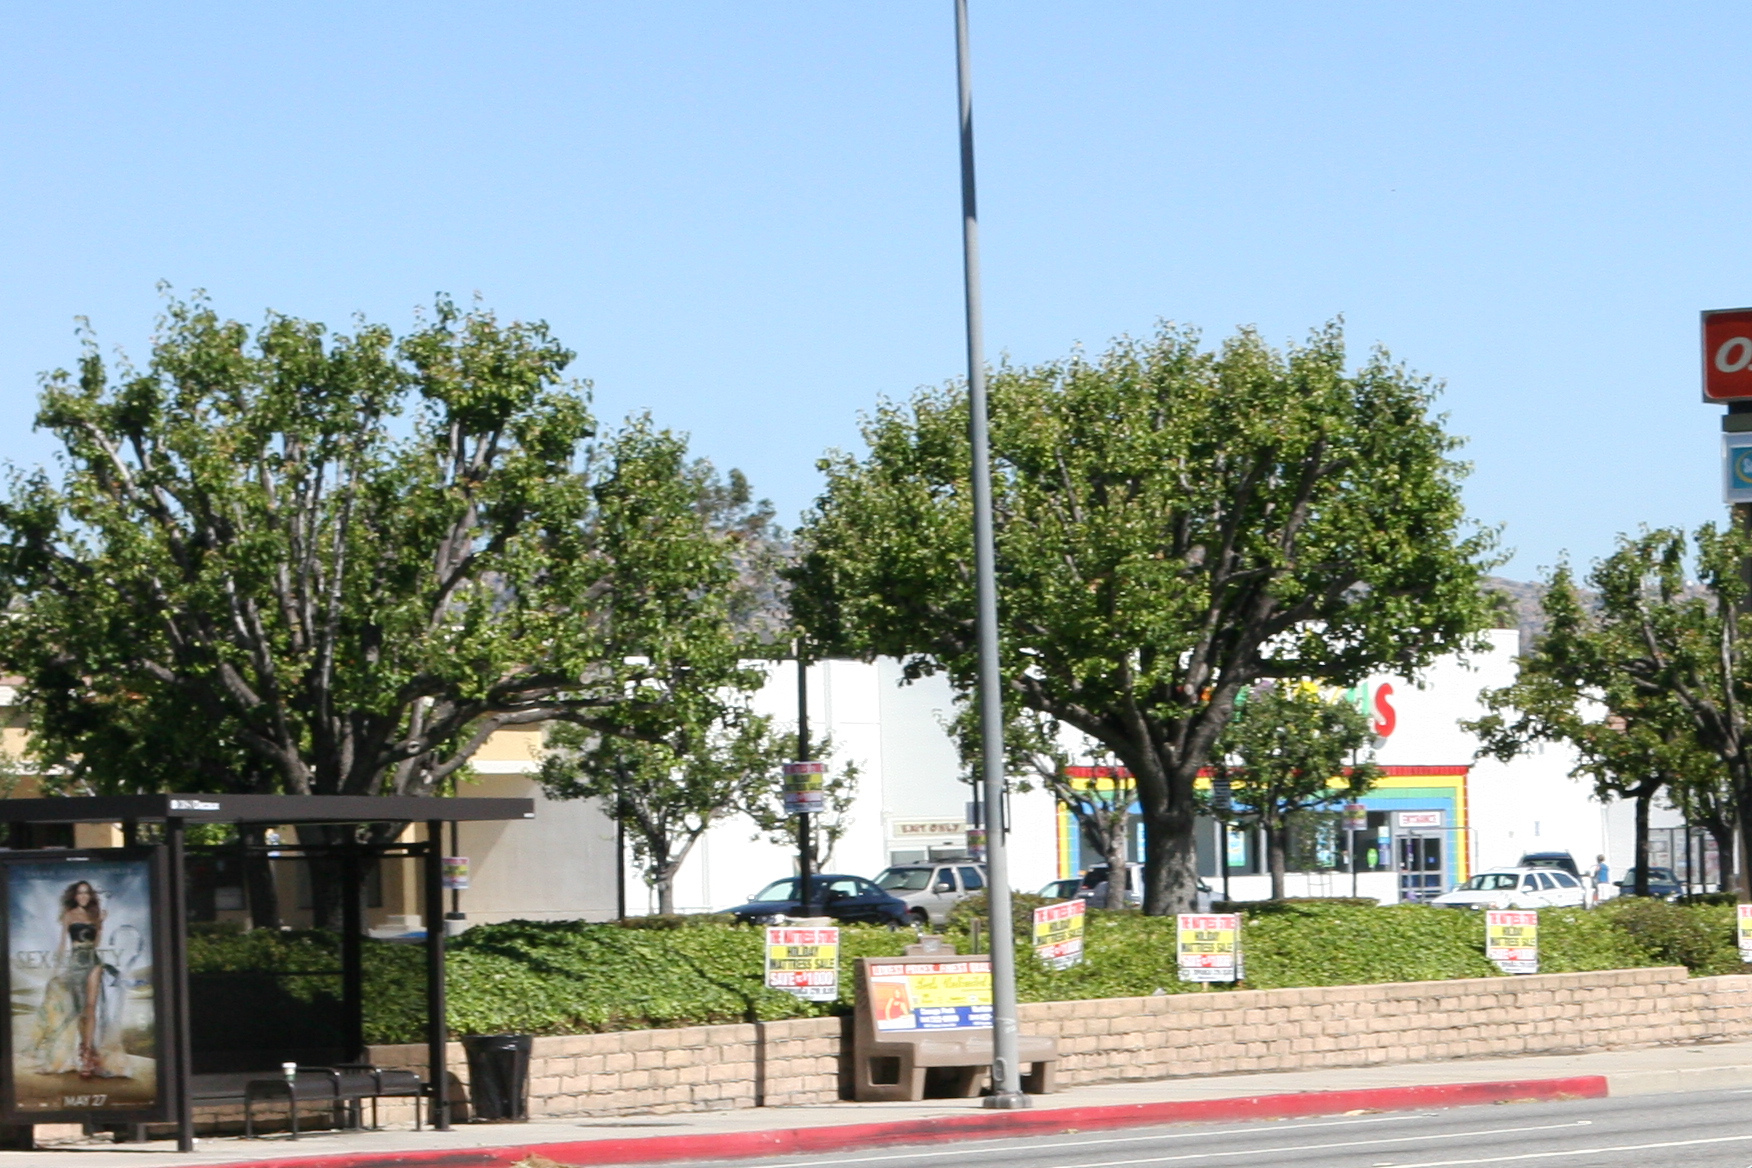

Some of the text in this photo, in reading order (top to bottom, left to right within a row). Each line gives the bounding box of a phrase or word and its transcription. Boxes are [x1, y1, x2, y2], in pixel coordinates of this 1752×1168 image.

[902, 823, 959, 833] EXIT ONLY
[64, 1094, 107, 1108] MAY 27
